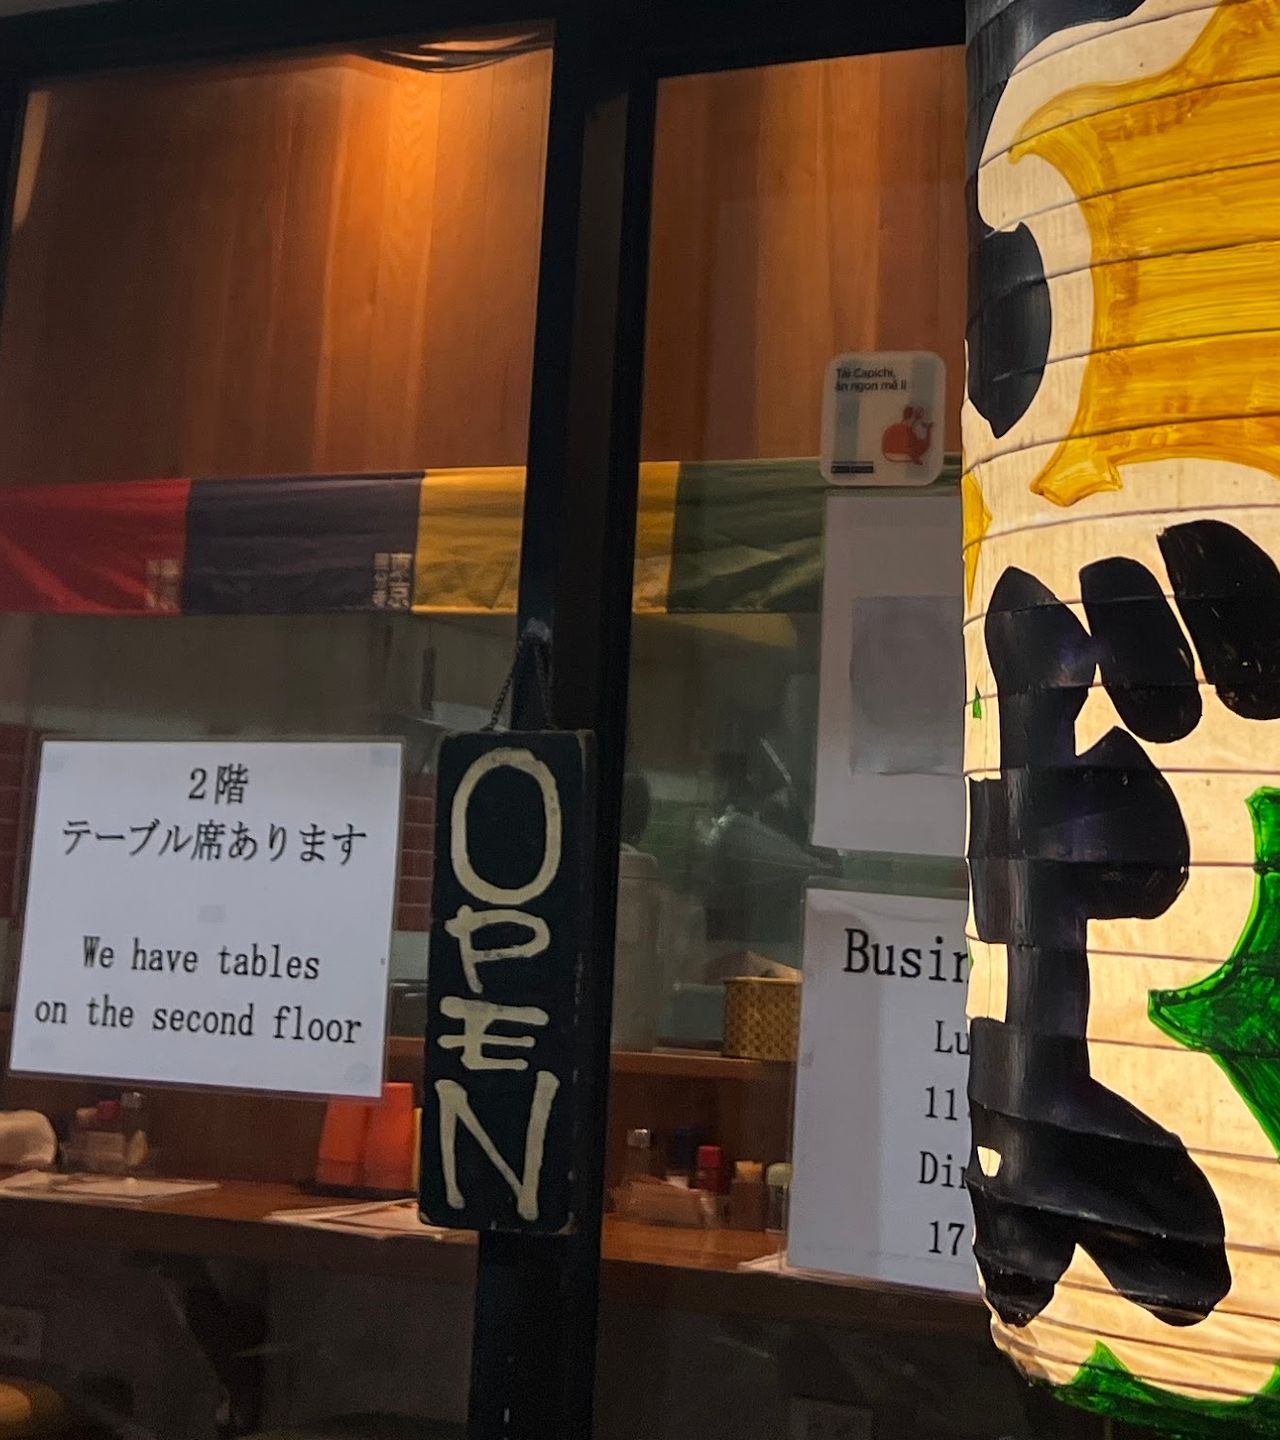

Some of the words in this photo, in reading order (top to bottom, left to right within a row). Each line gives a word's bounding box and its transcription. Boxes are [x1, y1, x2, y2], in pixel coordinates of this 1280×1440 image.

[188, 763, 249, 805] 2階
[62, 817, 367, 866] テーブル席あります
[82, 936, 114, 969] We
[131, 938, 198, 974] have
[218, 944, 320, 980] tables
[435, 747, 562, 1221] OPEN
[34, 998, 68, 1026] on
[86, 996, 134, 1029] the
[152, 1002, 254, 1037] second
[272, 1006, 362, 1045] floor
